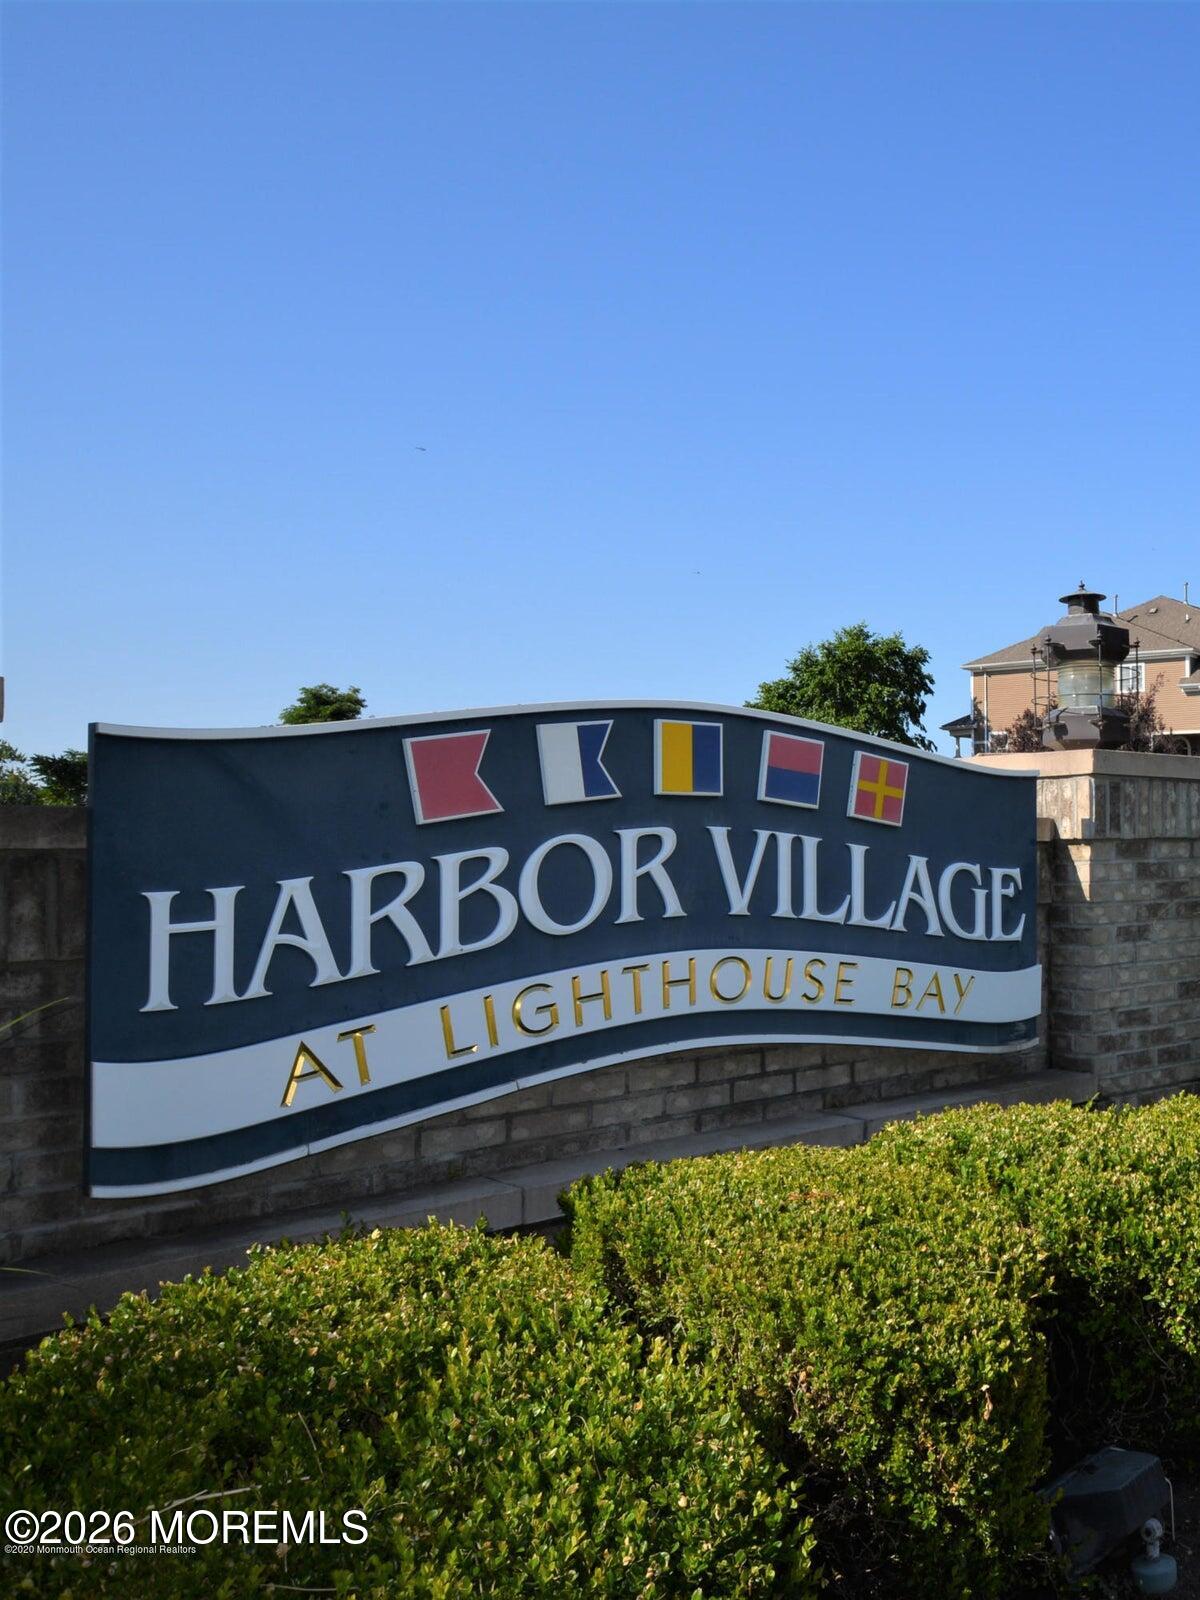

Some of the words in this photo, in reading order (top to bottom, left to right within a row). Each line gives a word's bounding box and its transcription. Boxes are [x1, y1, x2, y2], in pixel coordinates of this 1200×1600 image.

[139, 826, 687, 1013] HARBOR
[707, 825, 1026, 943] VILLAGE
[280, 1024, 377, 1108] AT
[439, 956, 860, 1060] LIGHTHOUSE
[890, 966, 976, 1016] BAY
